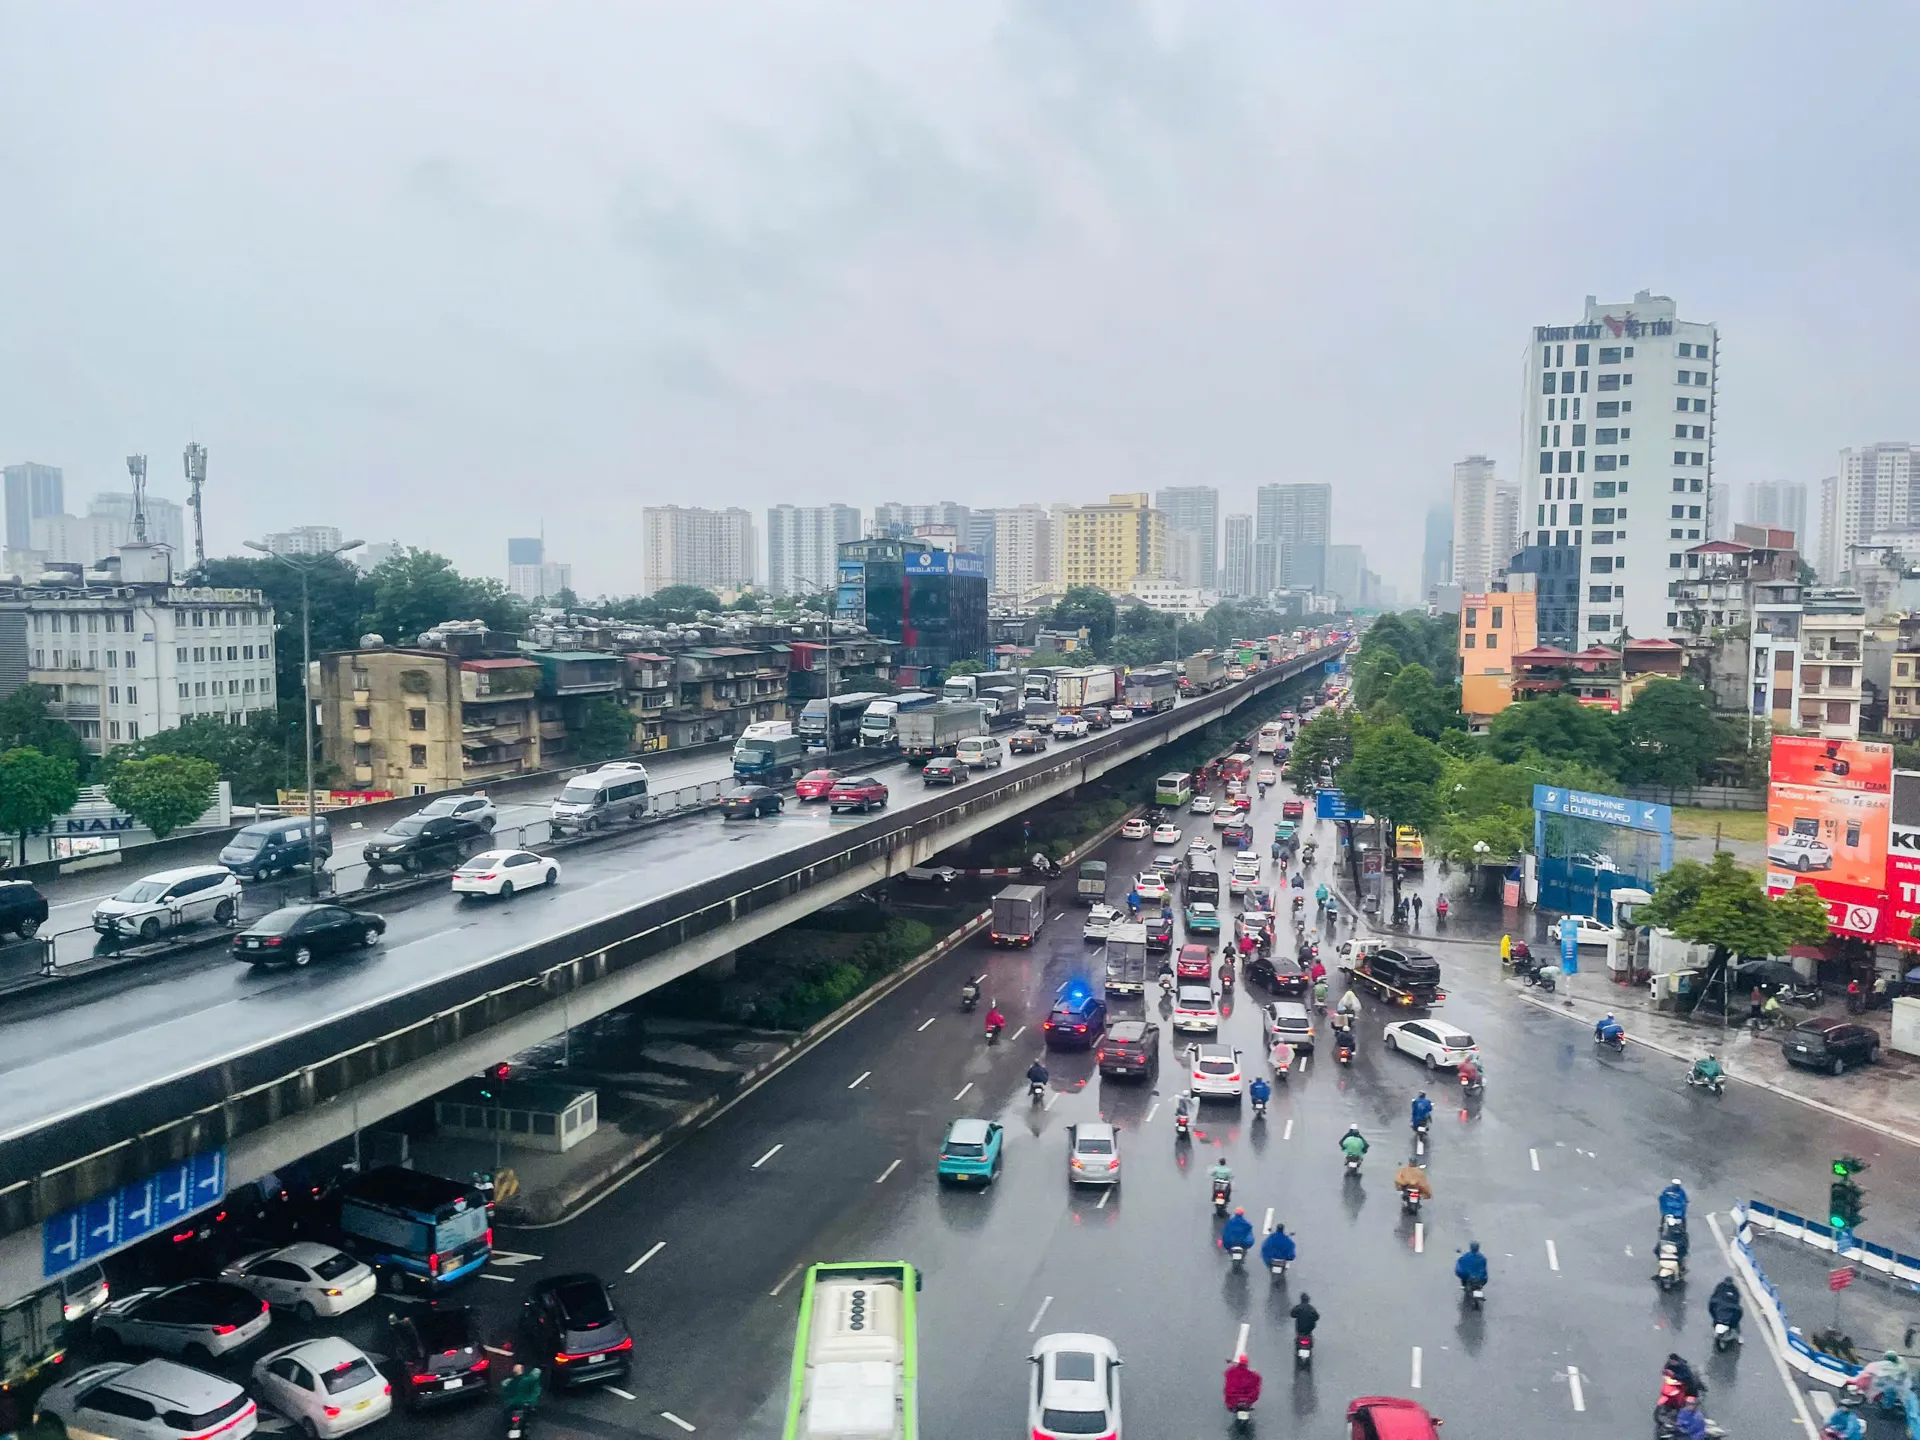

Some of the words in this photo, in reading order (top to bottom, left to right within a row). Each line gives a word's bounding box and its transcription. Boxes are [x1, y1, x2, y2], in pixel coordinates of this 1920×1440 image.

[955, 558, 984, 573] MEDLATEC
[1569, 795, 1625, 811] SUNSHINE
[1562, 804, 1631, 823] BOULEVARD
[67, 817, 133, 832] NAM
